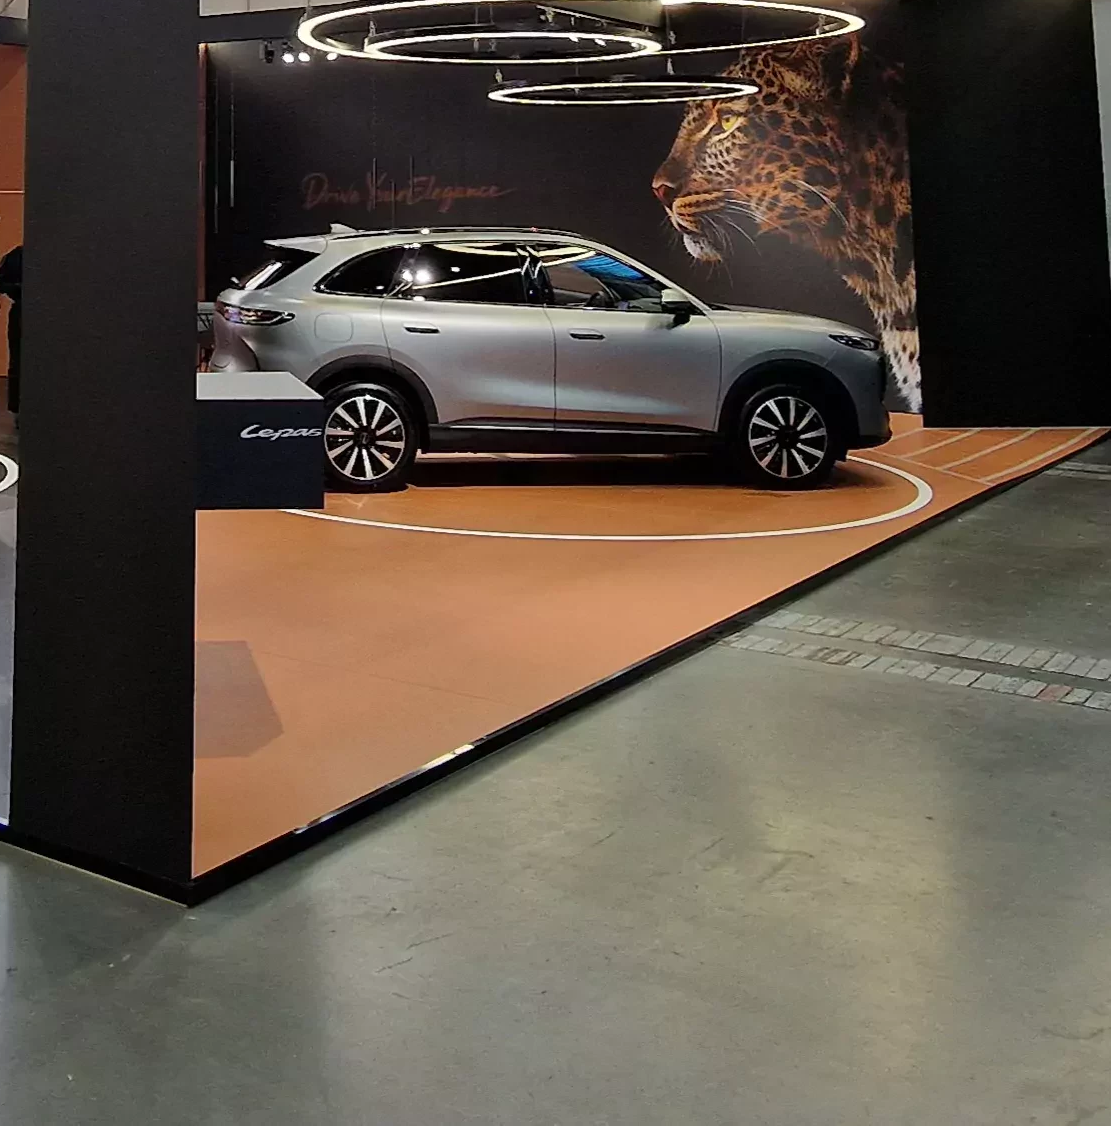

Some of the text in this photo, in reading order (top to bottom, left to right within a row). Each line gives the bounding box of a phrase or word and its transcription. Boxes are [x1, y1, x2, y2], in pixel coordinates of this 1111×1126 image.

[302, 173, 359, 210] Drive
[408, 175, 516, 213] Elegance
[239, 424, 322, 441] Lepas
